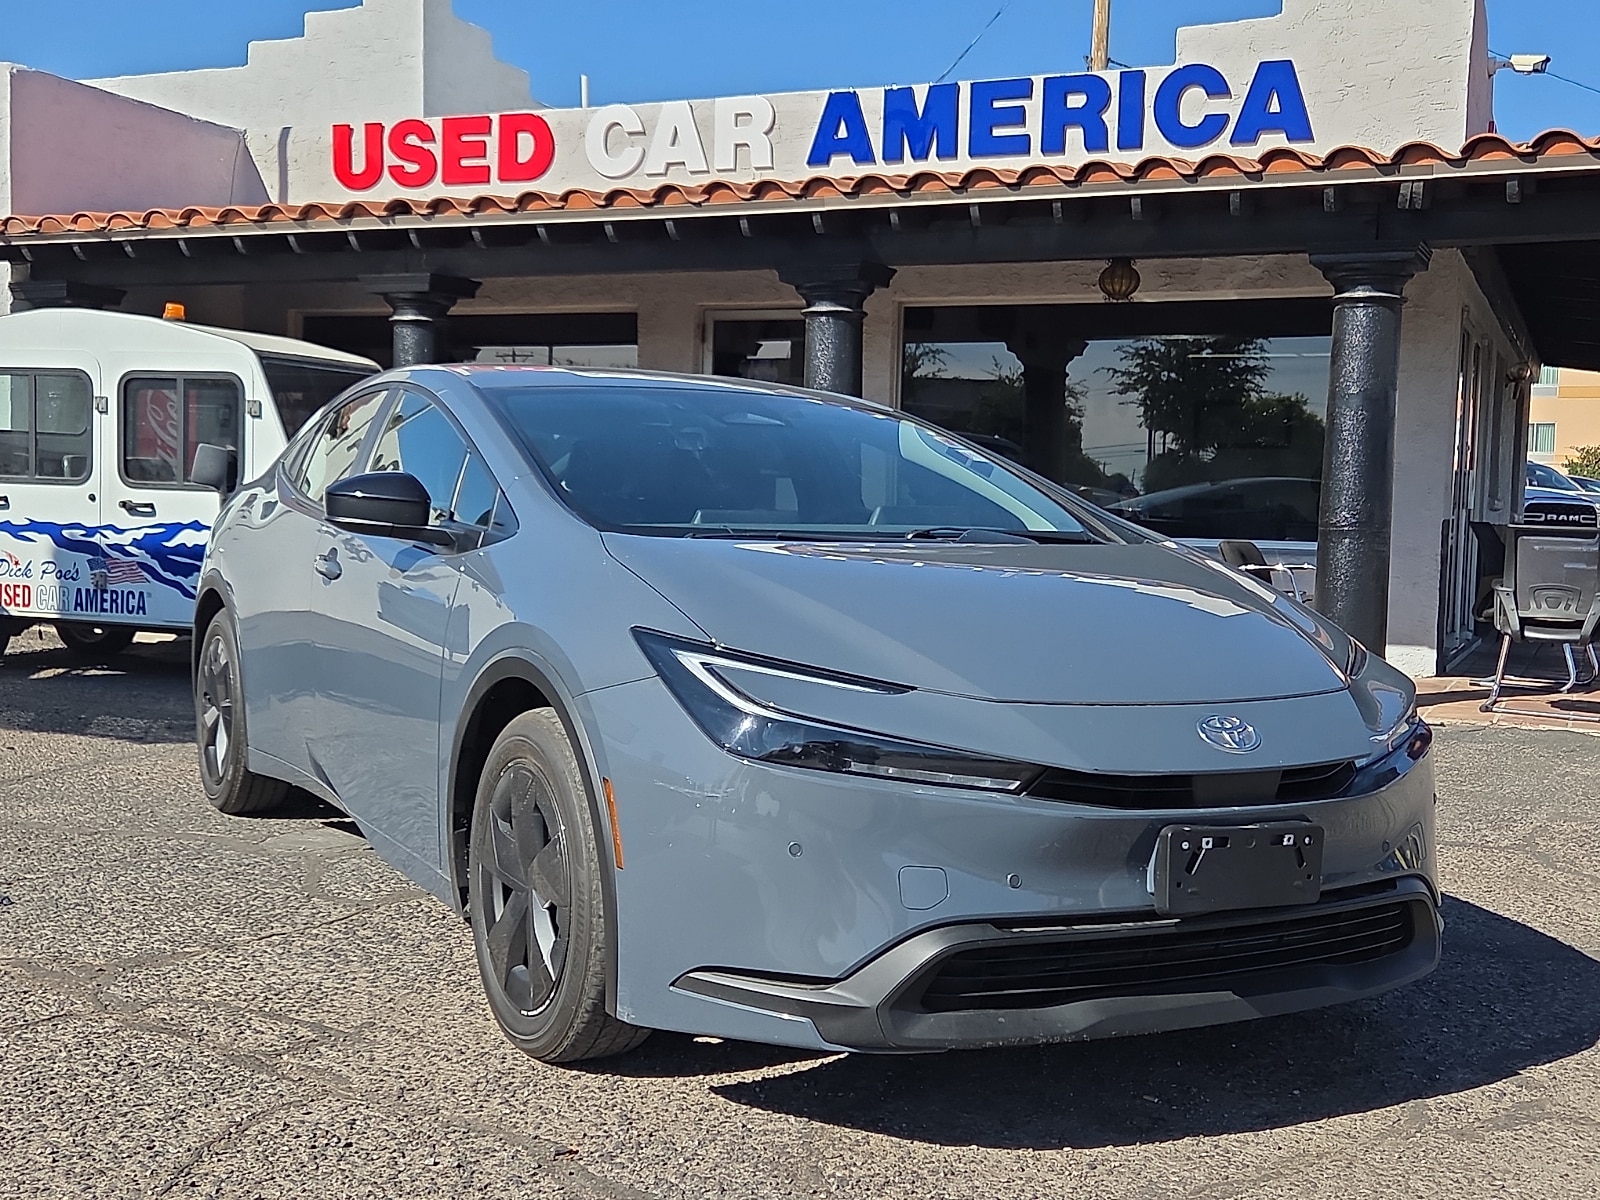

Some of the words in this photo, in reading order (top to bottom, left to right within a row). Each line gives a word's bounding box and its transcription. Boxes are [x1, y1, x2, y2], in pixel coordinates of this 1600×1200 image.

[332, 112, 557, 191] USED
[584, 95, 776, 179] CAR
[807, 58, 1314, 166] AMERICA
[0, 558, 34, 579] Dick
[40, 560, 81, 581] Poe's
[36, 584, 70, 612] CAR
[73, 587, 147, 616] AMERICA
